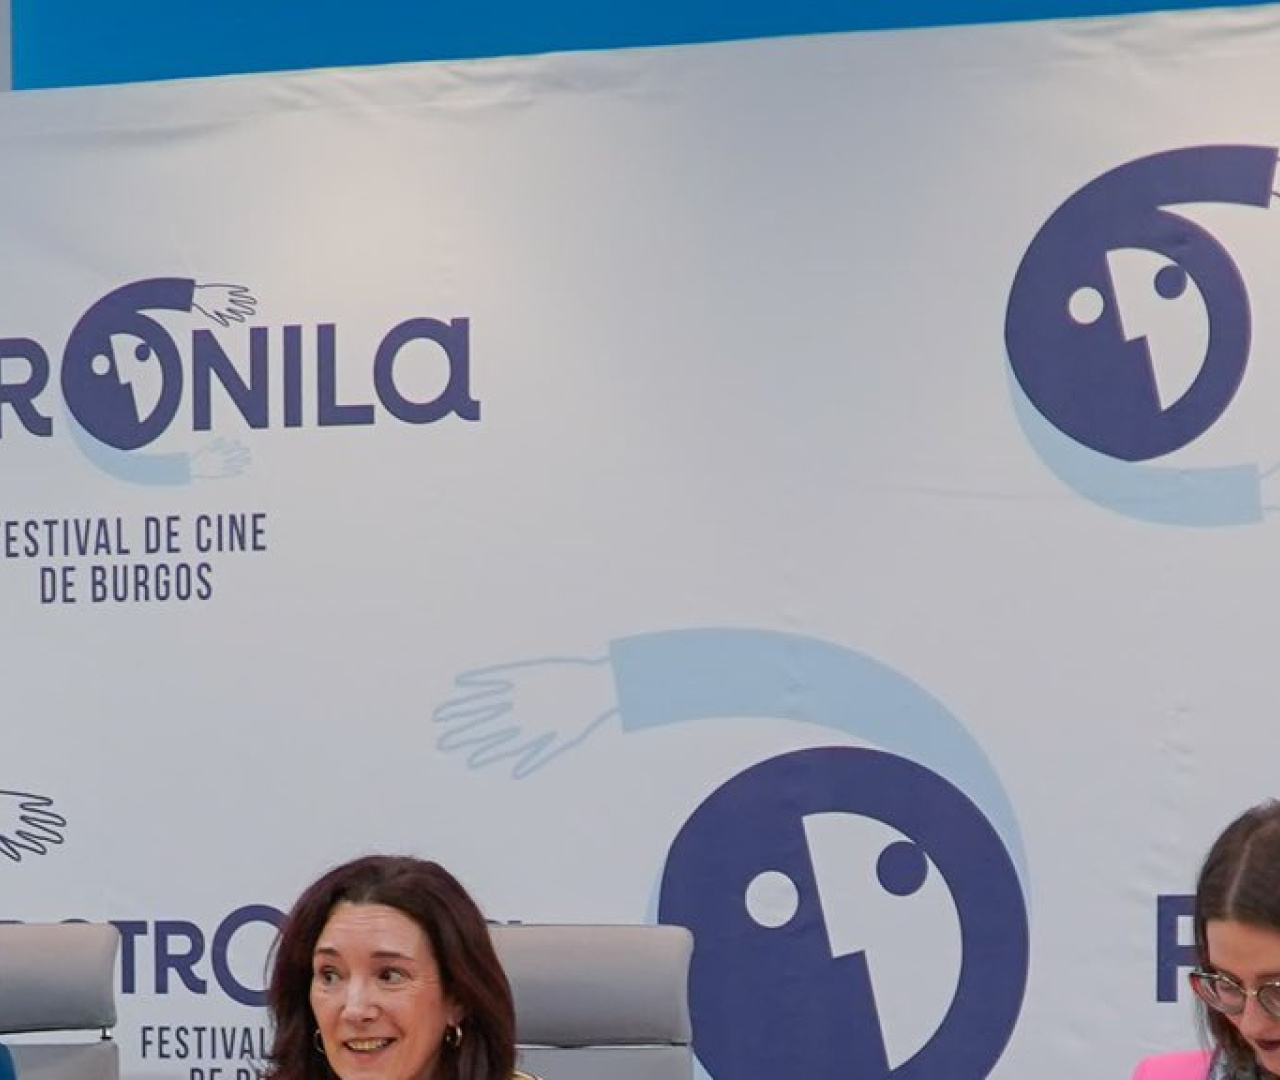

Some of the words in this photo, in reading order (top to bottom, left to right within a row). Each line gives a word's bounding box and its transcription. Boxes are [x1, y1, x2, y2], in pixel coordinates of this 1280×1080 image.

[143, 514, 183, 555] DE
[194, 512, 268, 555] CINE
[39, 565, 78, 606] DE
[90, 561, 213, 604] BURGOS
[140, 1025, 274, 1060] FESTIVAL
